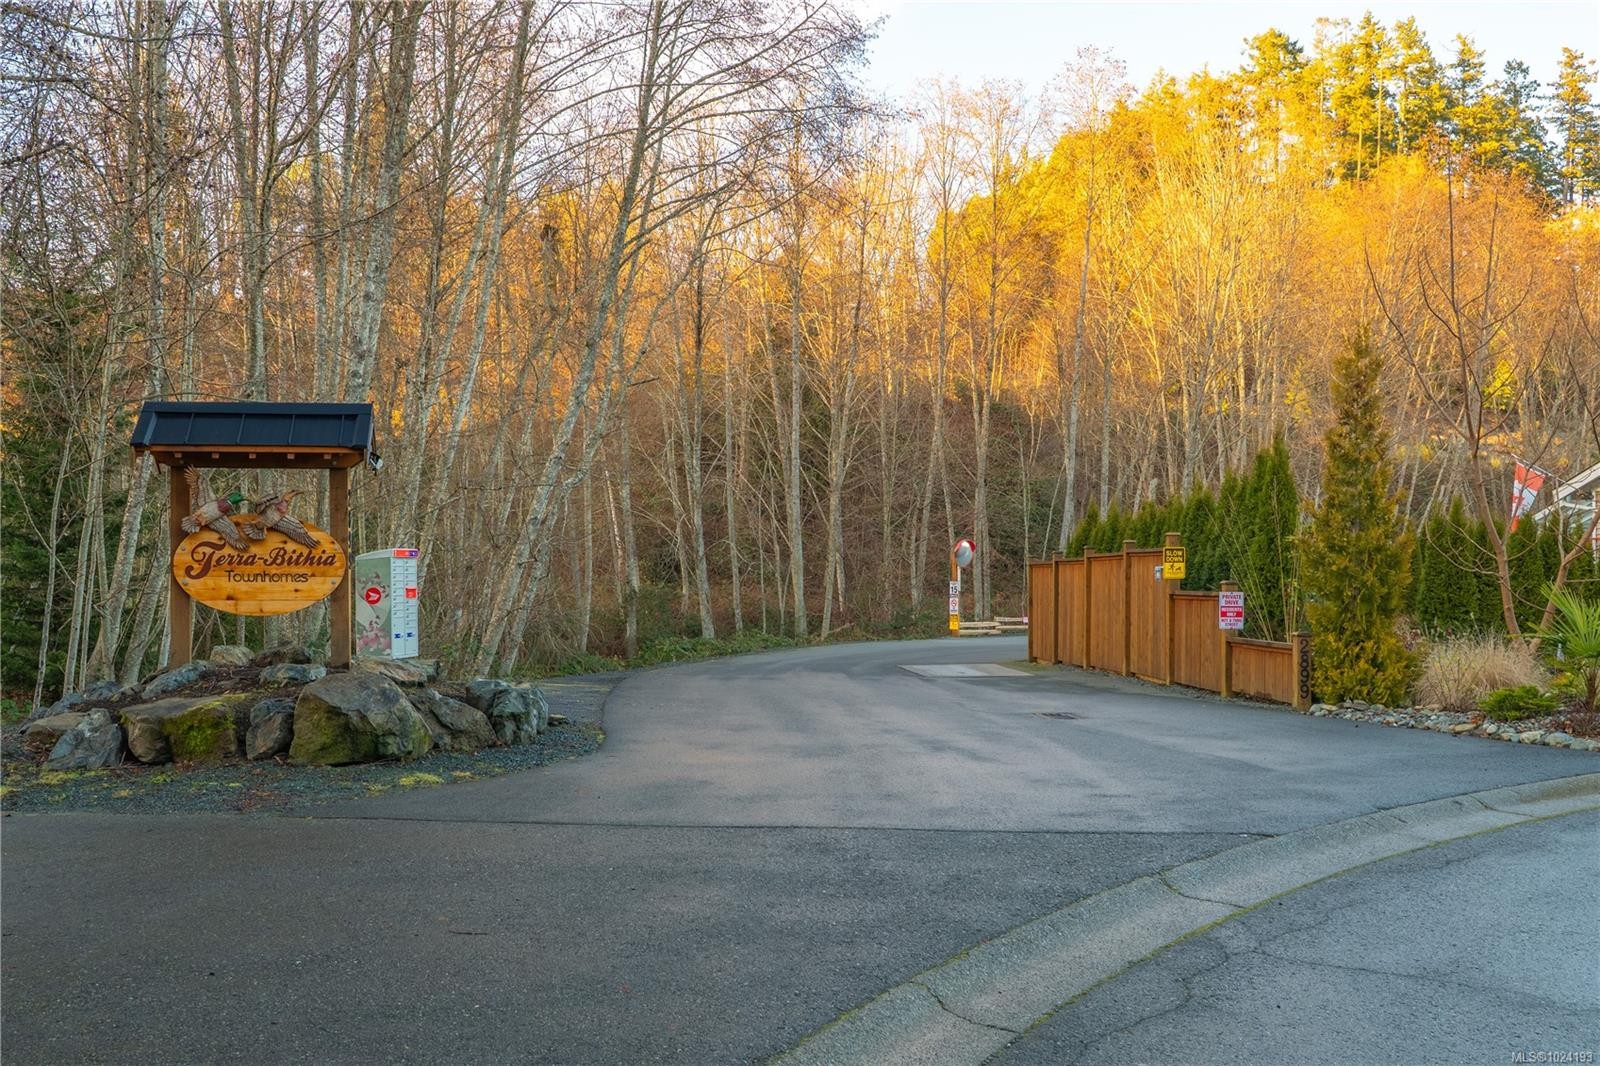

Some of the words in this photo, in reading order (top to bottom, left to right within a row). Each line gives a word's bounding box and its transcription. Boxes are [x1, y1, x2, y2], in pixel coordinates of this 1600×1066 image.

[185, 540, 336, 580] Terra-Bithia
[224, 569, 309, 583] Townhomes
[1300, 638, 1310, 699] 2899
